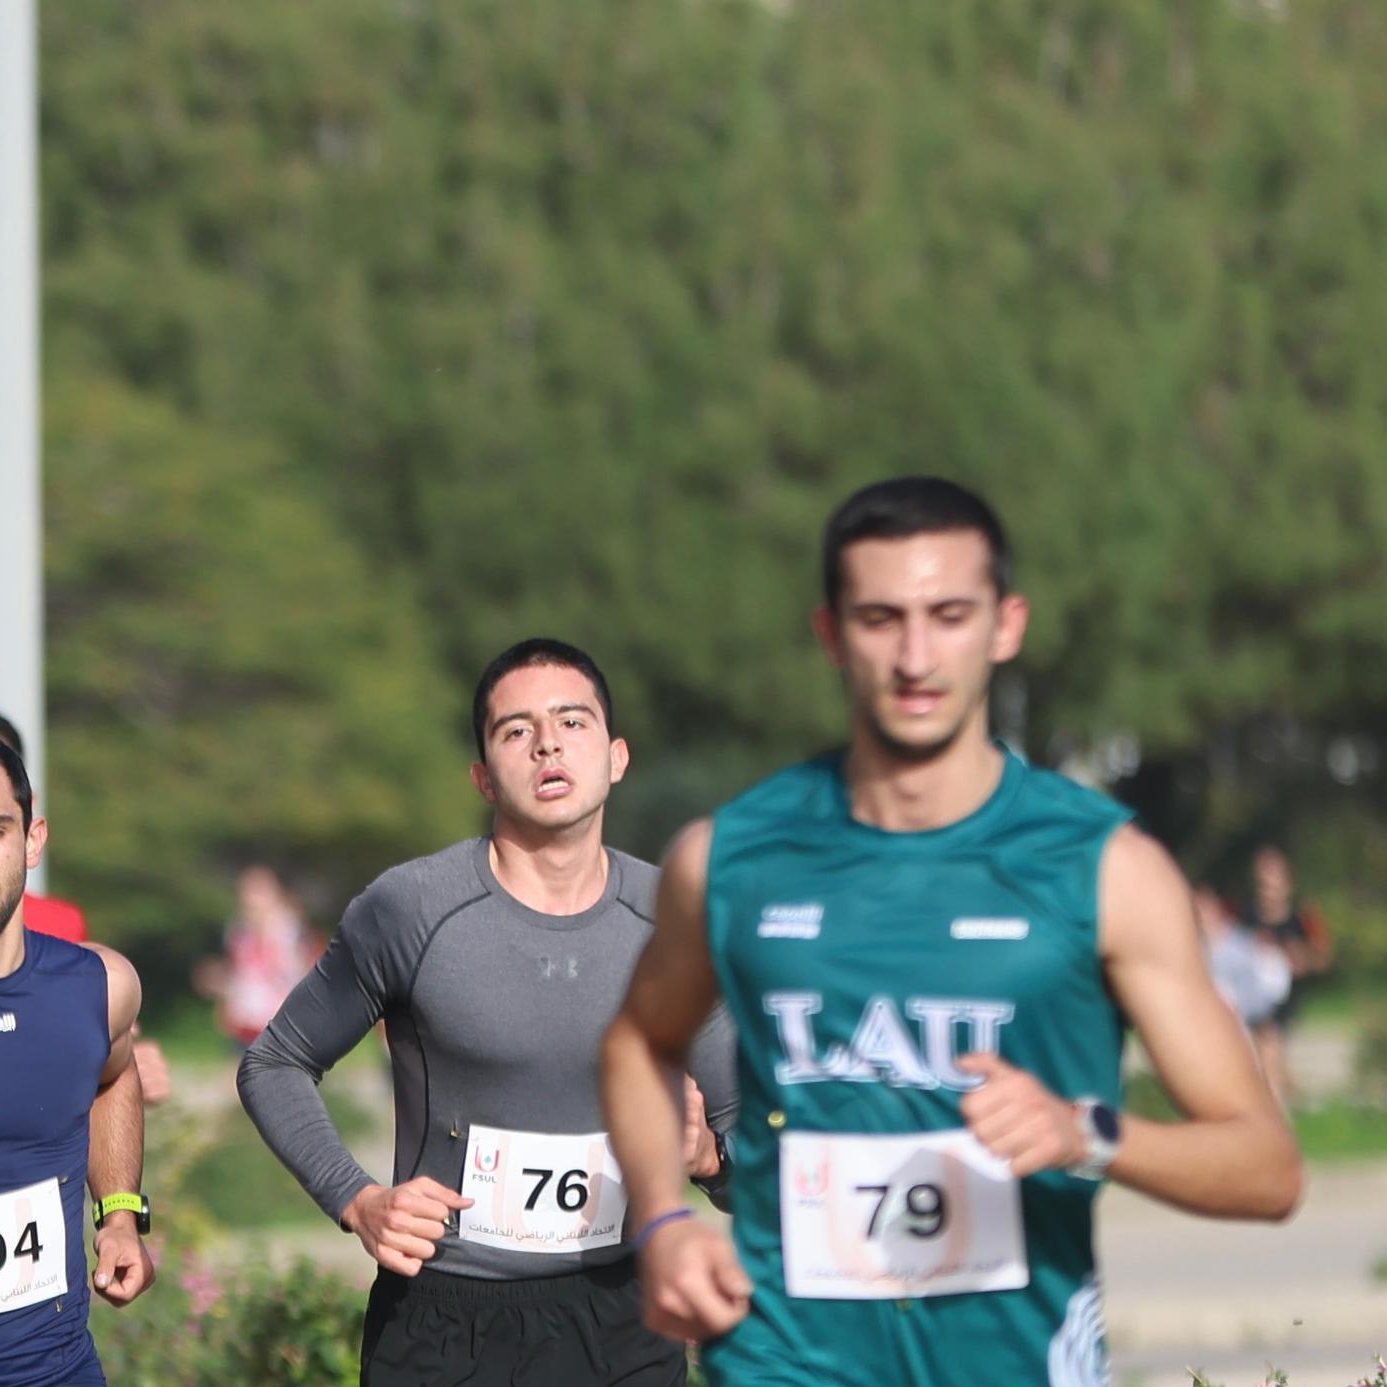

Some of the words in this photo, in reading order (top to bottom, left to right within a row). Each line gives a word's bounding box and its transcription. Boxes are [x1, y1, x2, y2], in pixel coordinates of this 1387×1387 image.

[762, 990, 1016, 1092] LAU
[472, 1173, 498, 1184] FSUL
[522, 1168, 589, 1213] 76
[854, 1183, 949, 1241] 79
